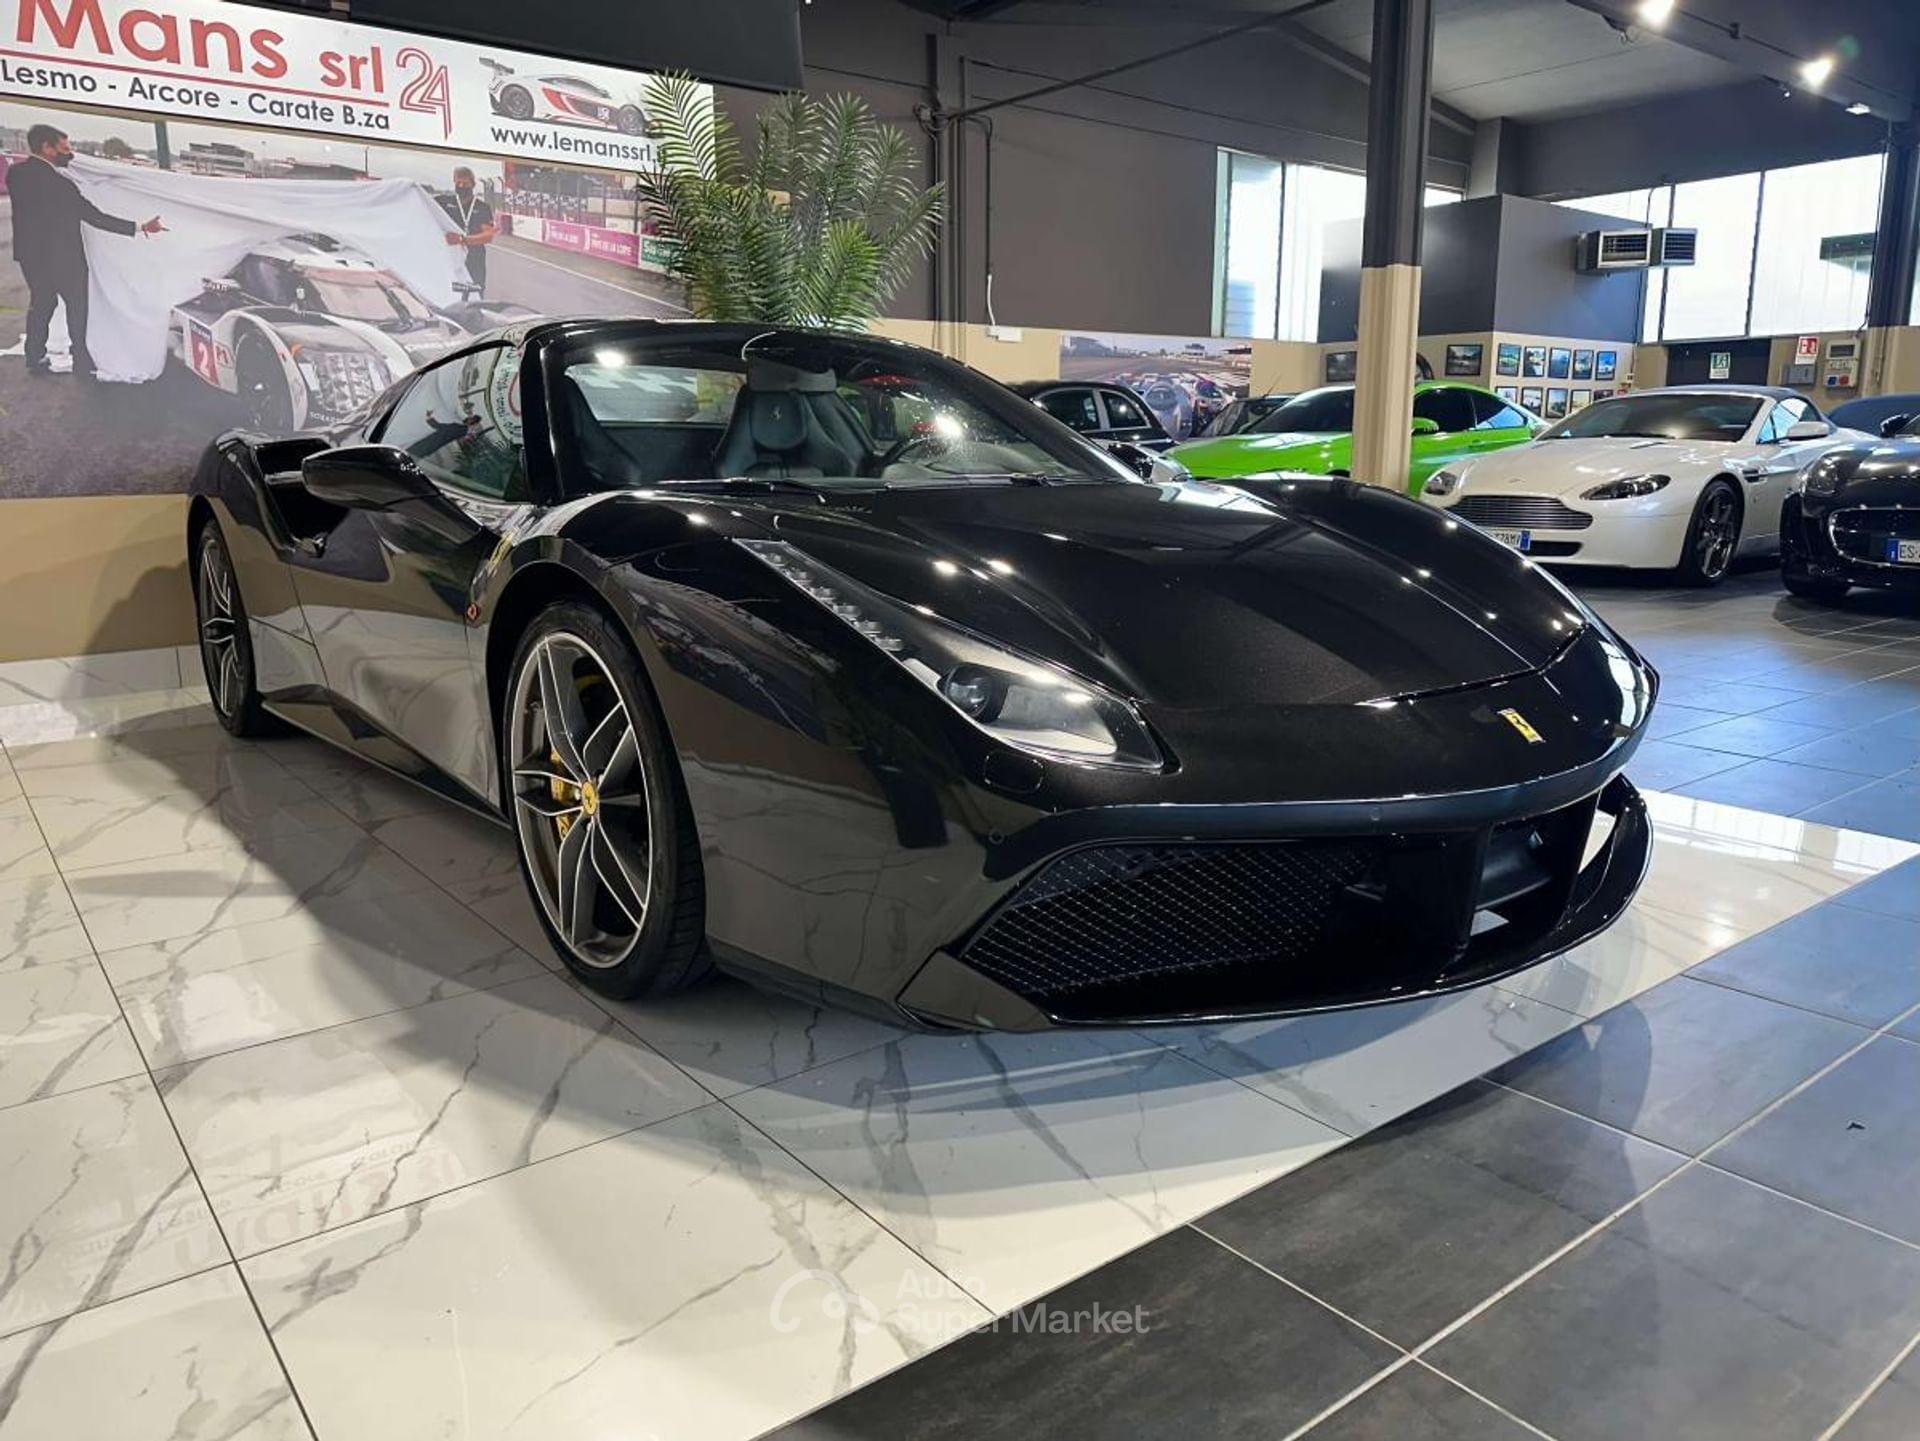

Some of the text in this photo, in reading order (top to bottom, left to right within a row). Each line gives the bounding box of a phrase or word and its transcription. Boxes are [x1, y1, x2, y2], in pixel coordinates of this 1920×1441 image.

[16, 0, 385, 94] Mans srl
[1, 60, 97, 93] Lesmo
[128, 77, 220, 109] Arcore
[247, 93, 335, 124] Carate
[343, 105, 390, 130] B.za
[198, 342, 211, 378] 2
[1899, 544, 1920, 559] ES
